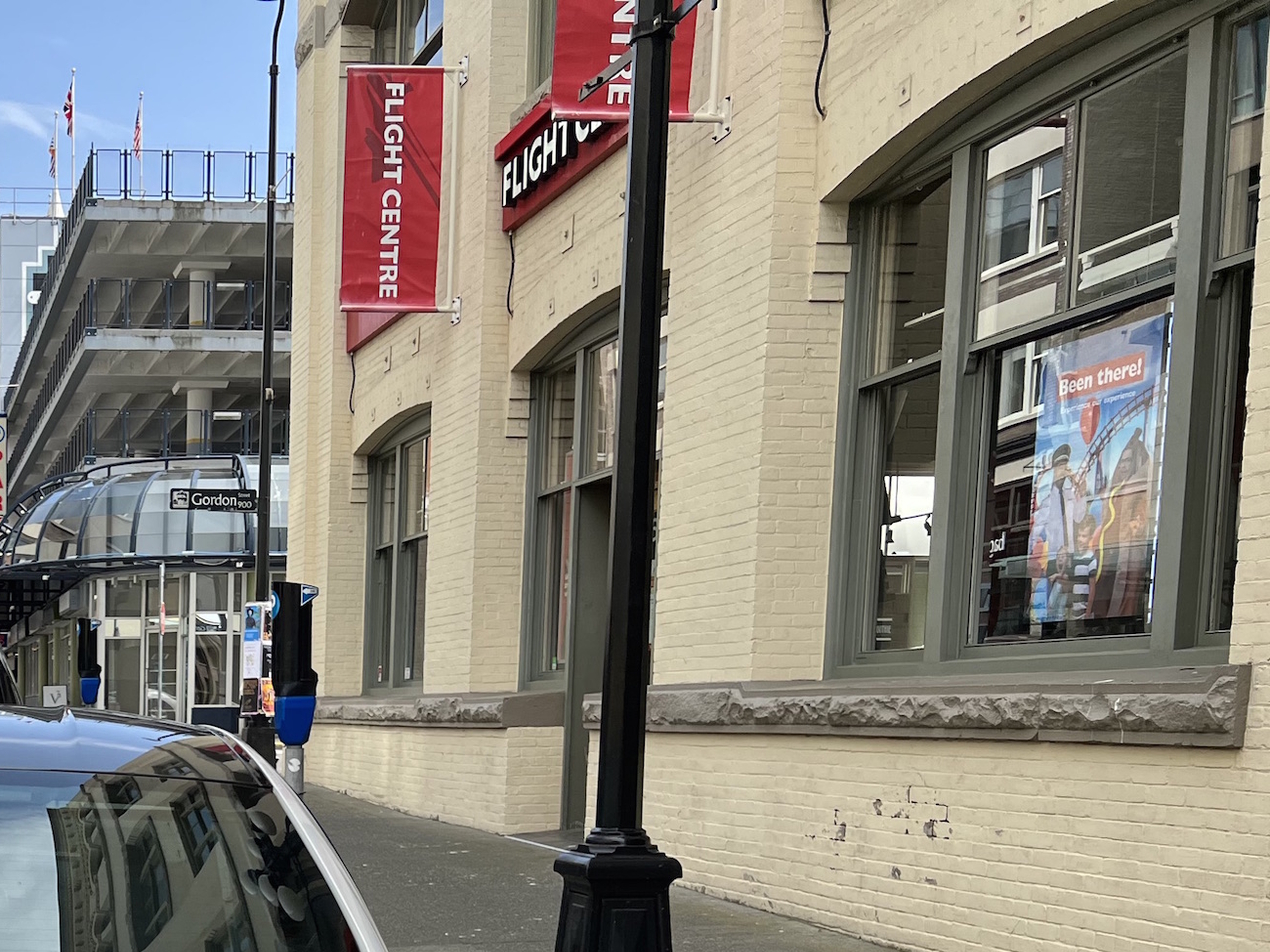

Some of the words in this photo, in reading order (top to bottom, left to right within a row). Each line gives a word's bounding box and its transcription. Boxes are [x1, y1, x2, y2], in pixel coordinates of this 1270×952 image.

[383, 82, 405, 184] FLIGHT
[502, 121, 568, 207] FLIGHT
[378, 190, 402, 299] CENTRE
[1058, 374, 1093, 396] Been
[1097, 357, 1143, 386] there!
[191, 493, 237, 507] Gordon
[237, 501, 252, 509] 900
